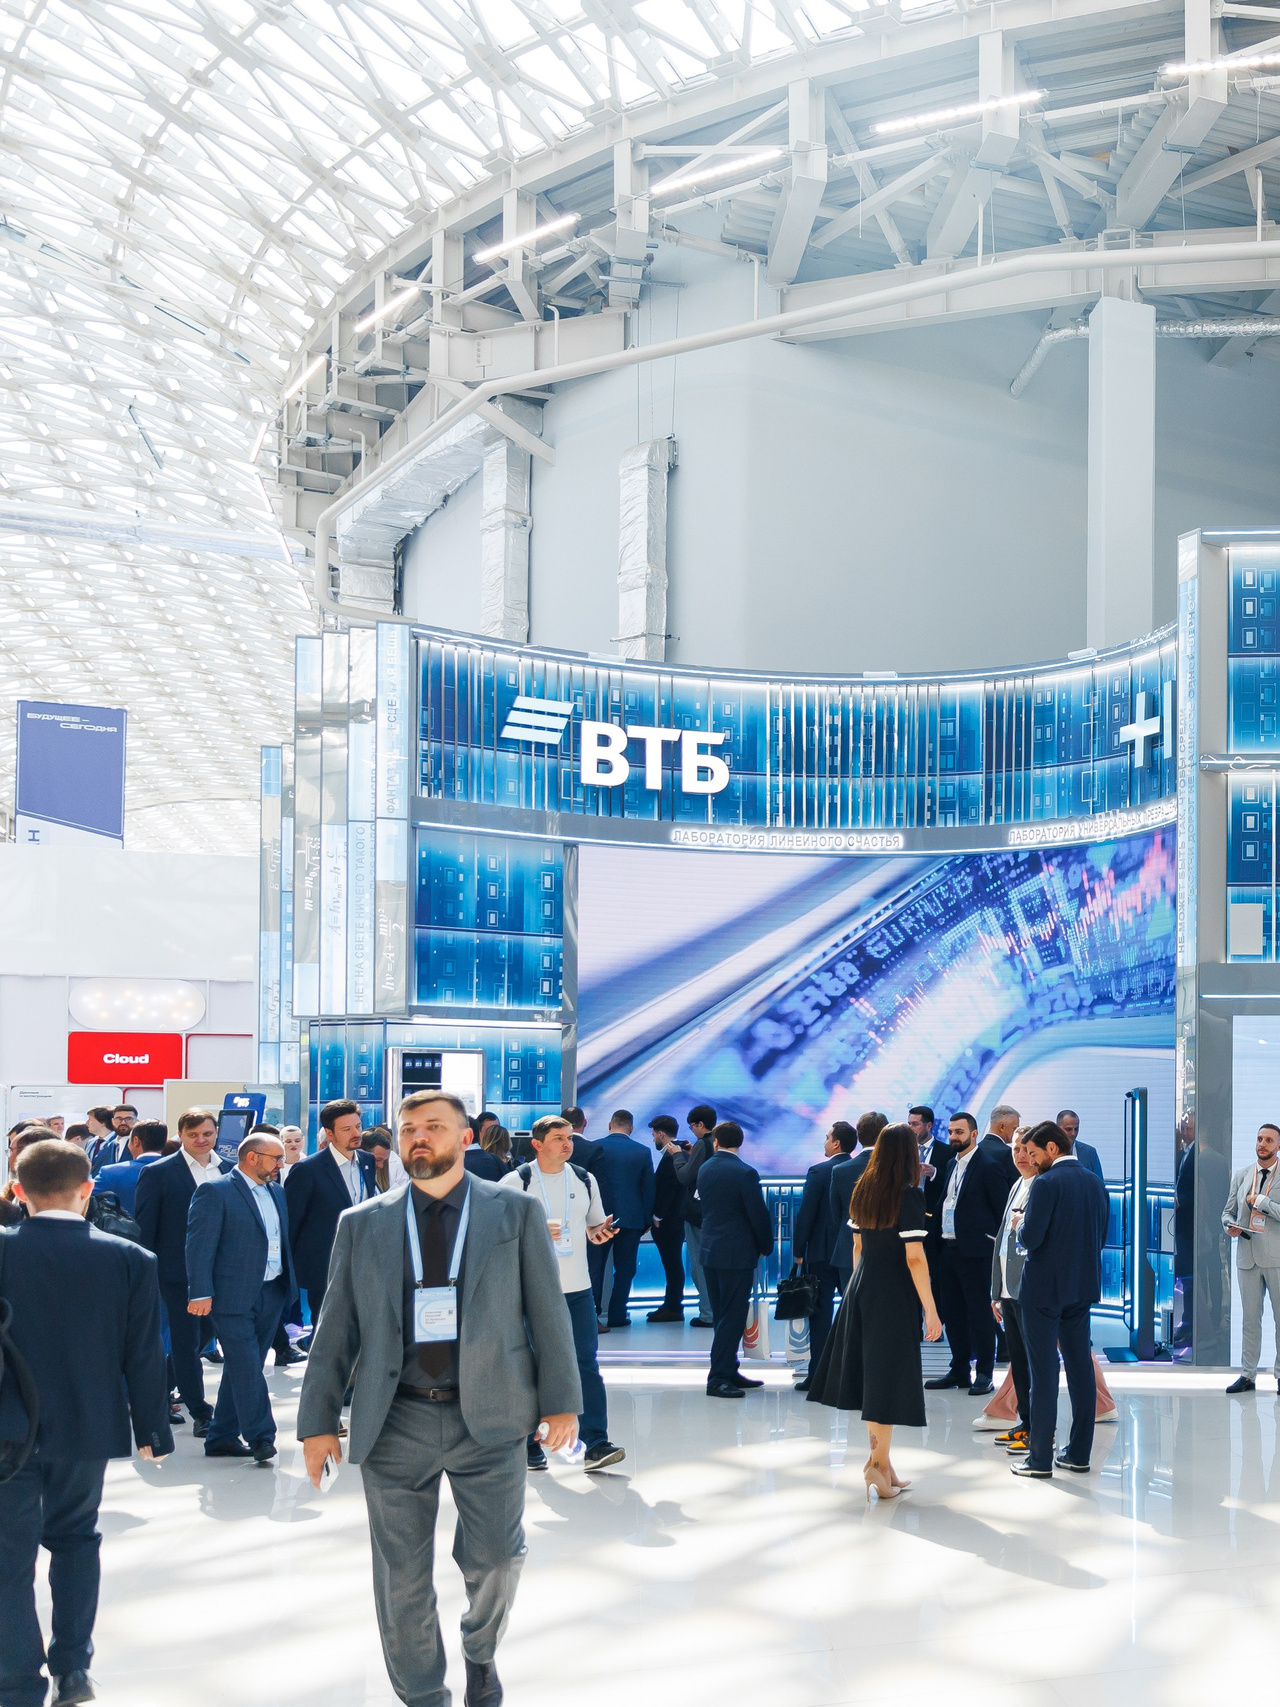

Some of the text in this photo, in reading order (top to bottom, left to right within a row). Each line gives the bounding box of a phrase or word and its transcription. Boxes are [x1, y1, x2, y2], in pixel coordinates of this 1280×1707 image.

[26, 712, 81, 723] БУДУЩЕЕ
[59, 722, 118, 733] СЕГОДНЯ
[580, 720, 731, 794] ВТБ
[673, 830, 901, 848] ЛАБОРАТОРИЯ ЛИНЕЙНОГО СЧАСТЬЯ
[1008, 824, 1076, 843] ЛАБОРАТОРИЯ
[1178, 841, 1186, 879] БЫТЬ
[353, 826, 366, 1003] НЕТ НА СВЕТЕ НИЧЕГО ТАКОГО
[1178, 884, 1186, 932] МОЖЕТ
[103, 1053, 149, 1064] Cloud
